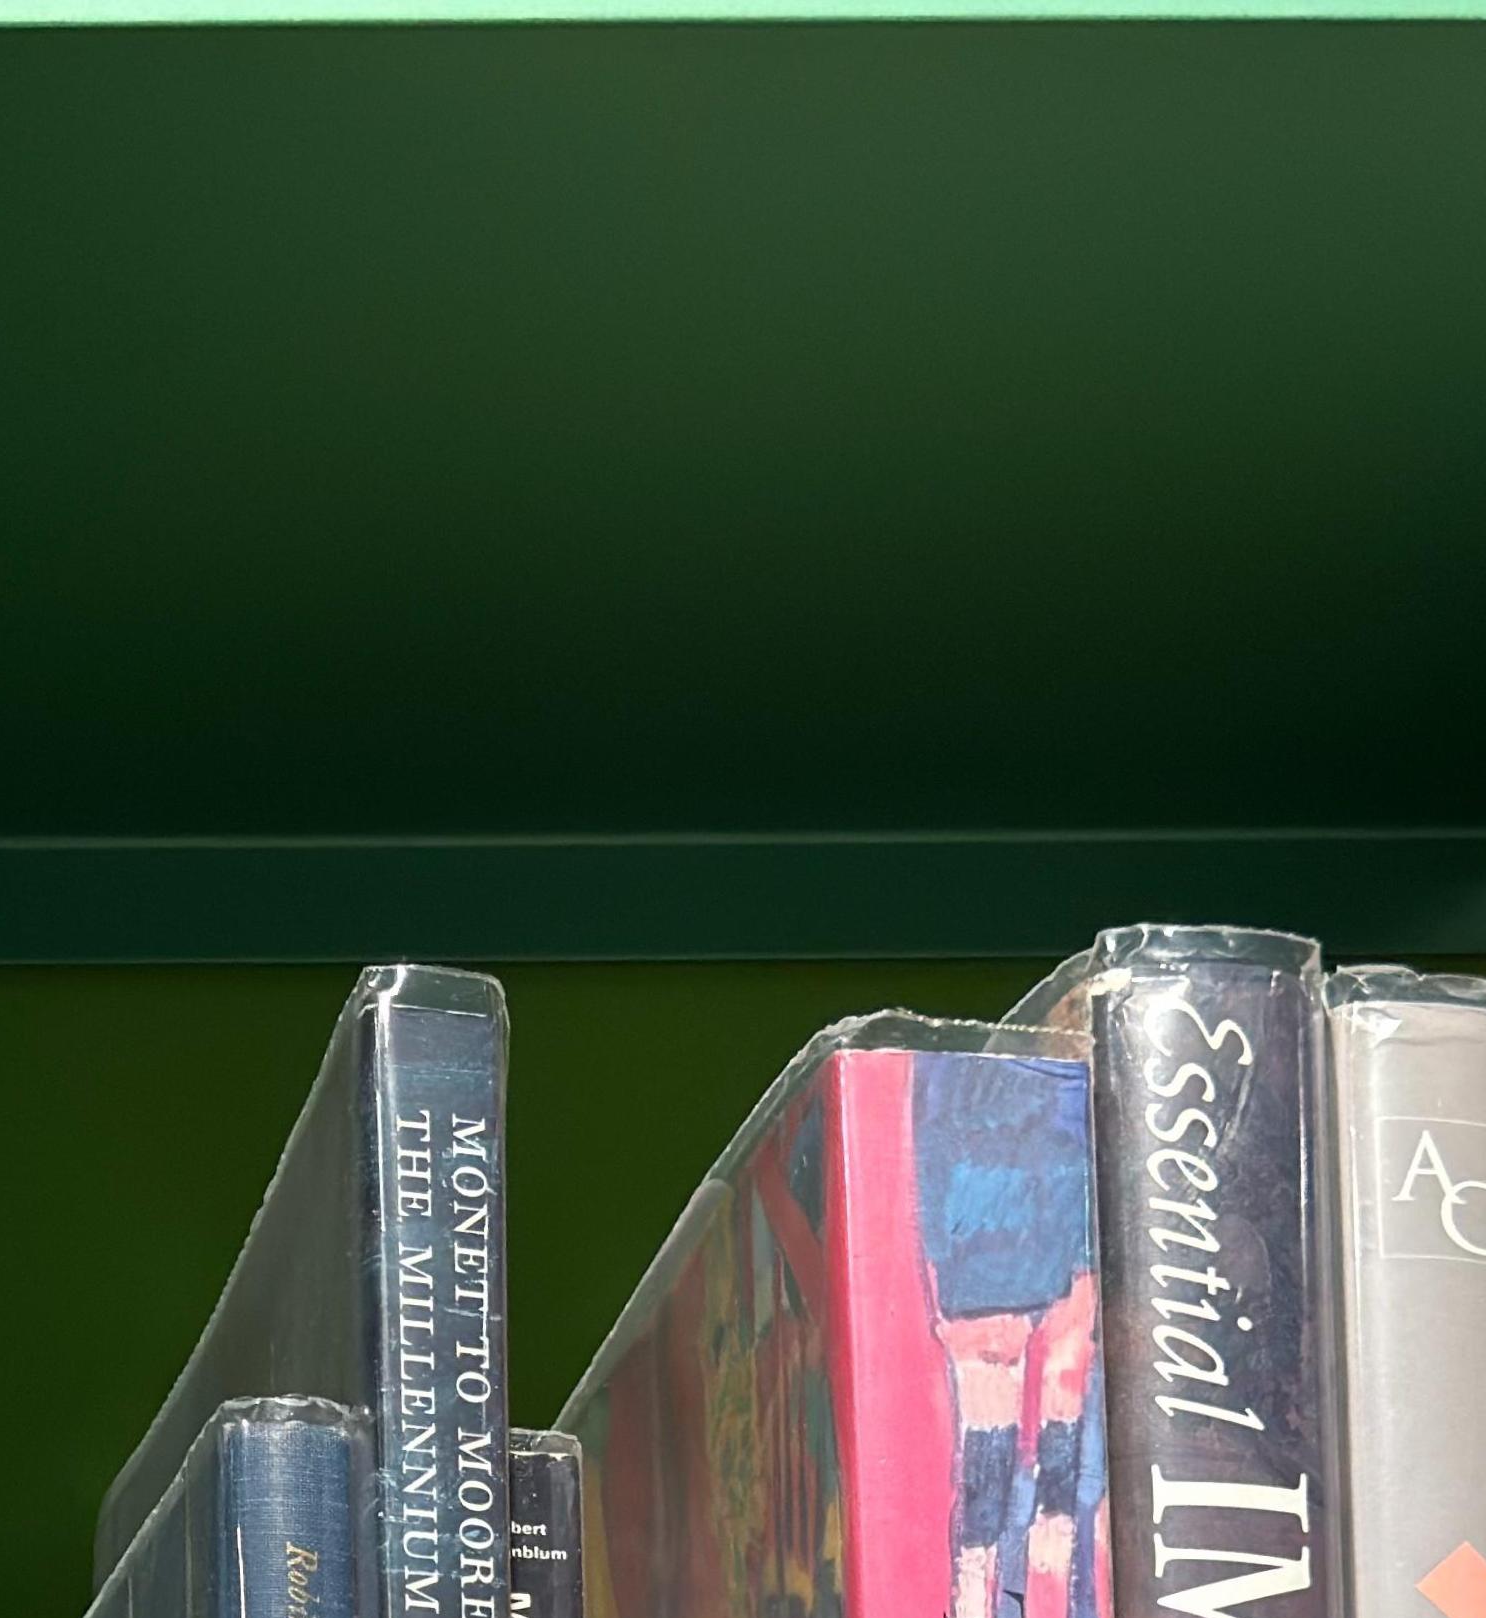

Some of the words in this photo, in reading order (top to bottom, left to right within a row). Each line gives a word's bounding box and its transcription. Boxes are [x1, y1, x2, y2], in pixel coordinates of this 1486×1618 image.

[395, 1110, 432, 1219] THE
[450, 1114, 491, 1314] MONET
[1140, 996, 1266, 1433] Essential
[455, 1336, 493, 1405] TO
[398, 1243, 441, 1615] MILLENNIUM
[511, 1520, 547, 1536] bert
[511, 1546, 567, 1561] nblum
